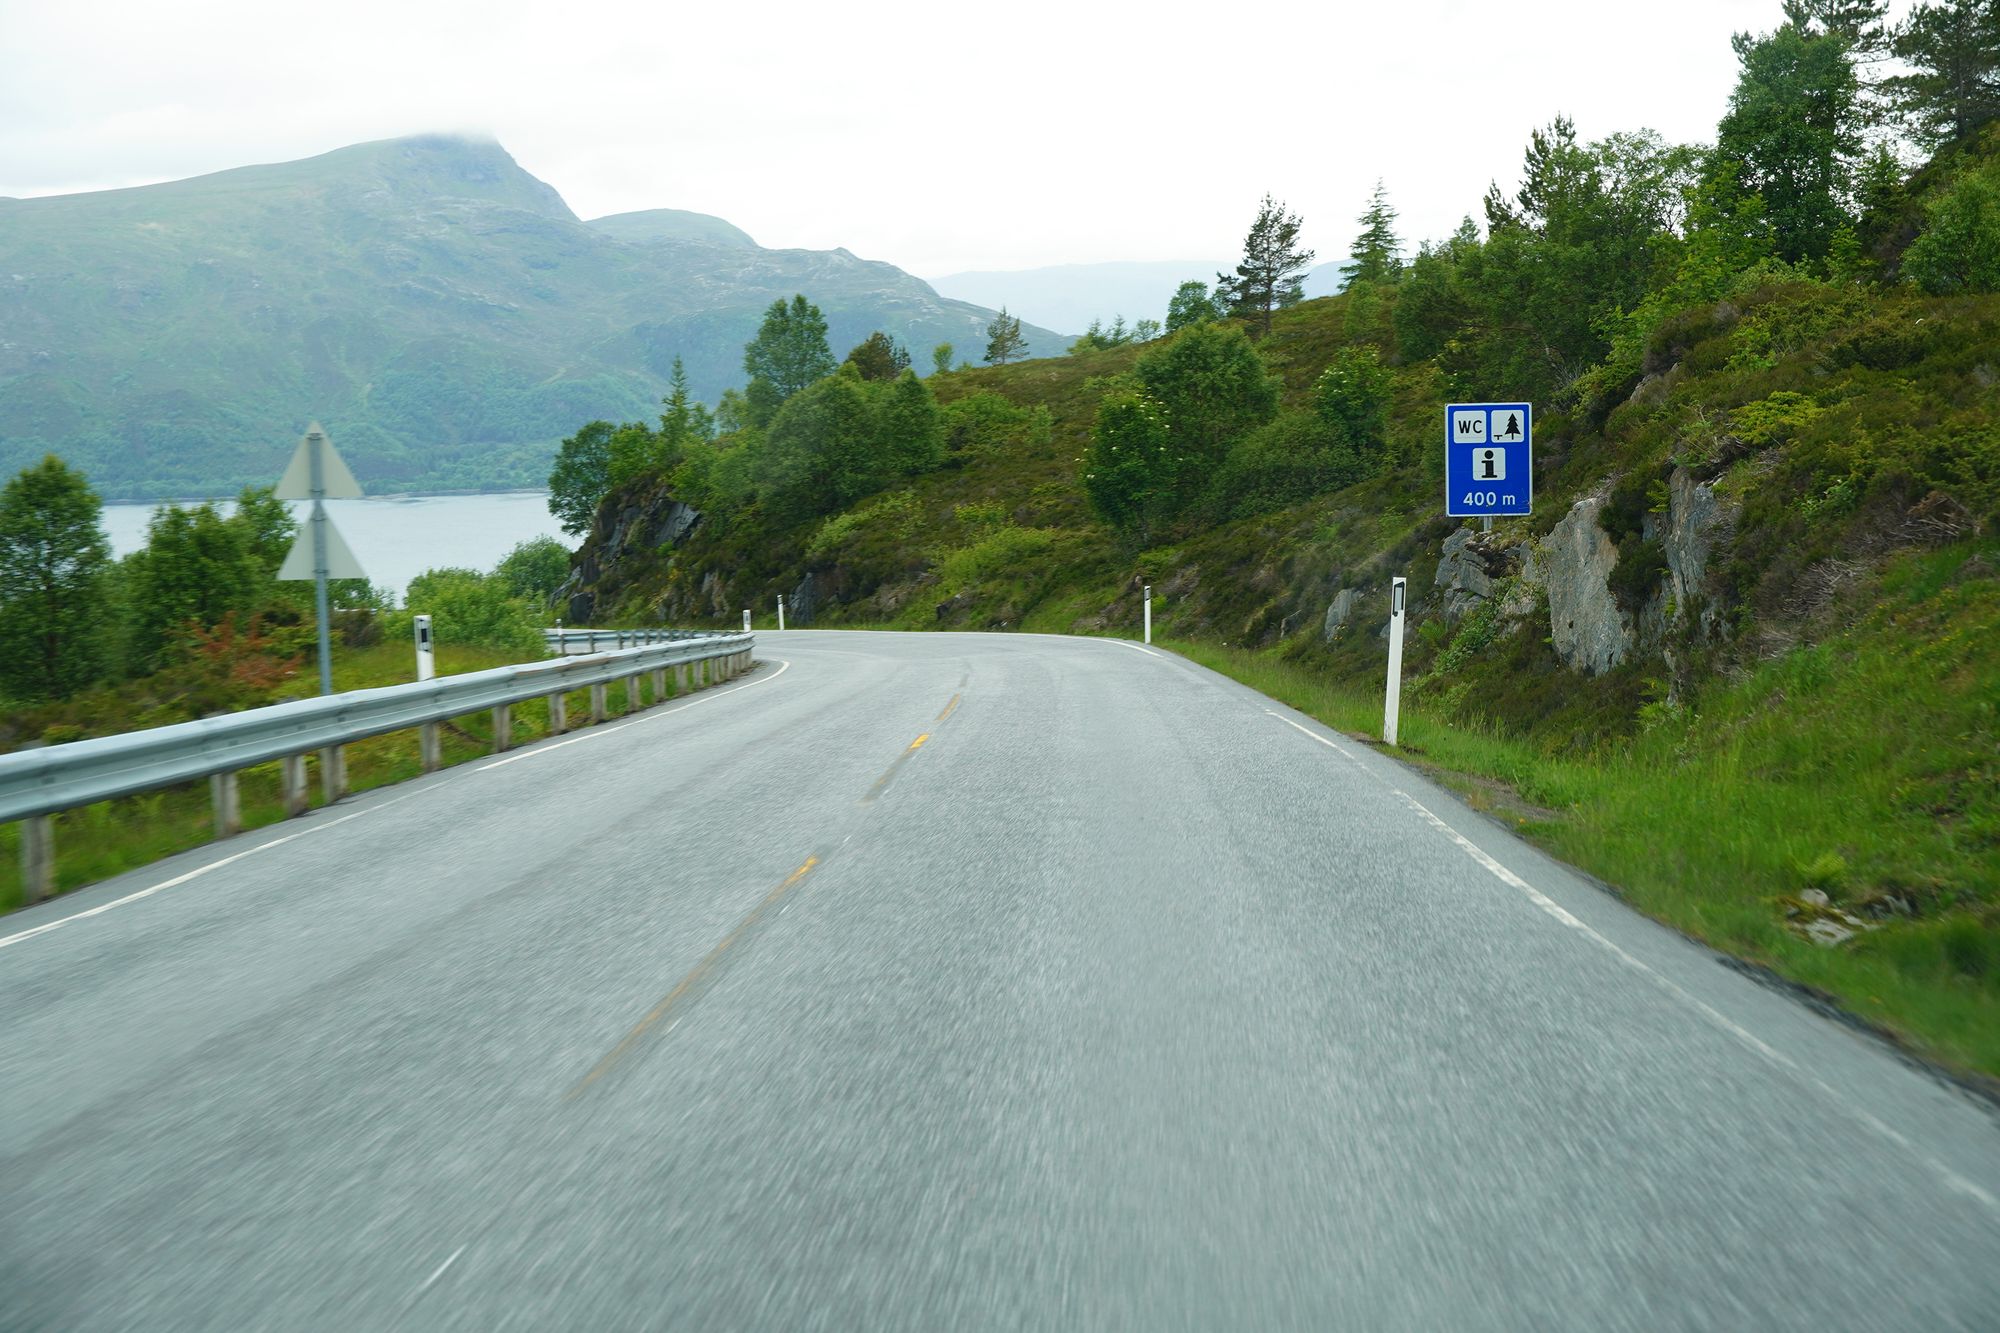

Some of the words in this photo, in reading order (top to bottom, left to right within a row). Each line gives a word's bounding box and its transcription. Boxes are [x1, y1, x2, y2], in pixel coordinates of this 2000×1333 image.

[1458, 420, 1482, 434] WC
[1463, 491, 1497, 506] 400
[1502, 495, 1516, 505] m
